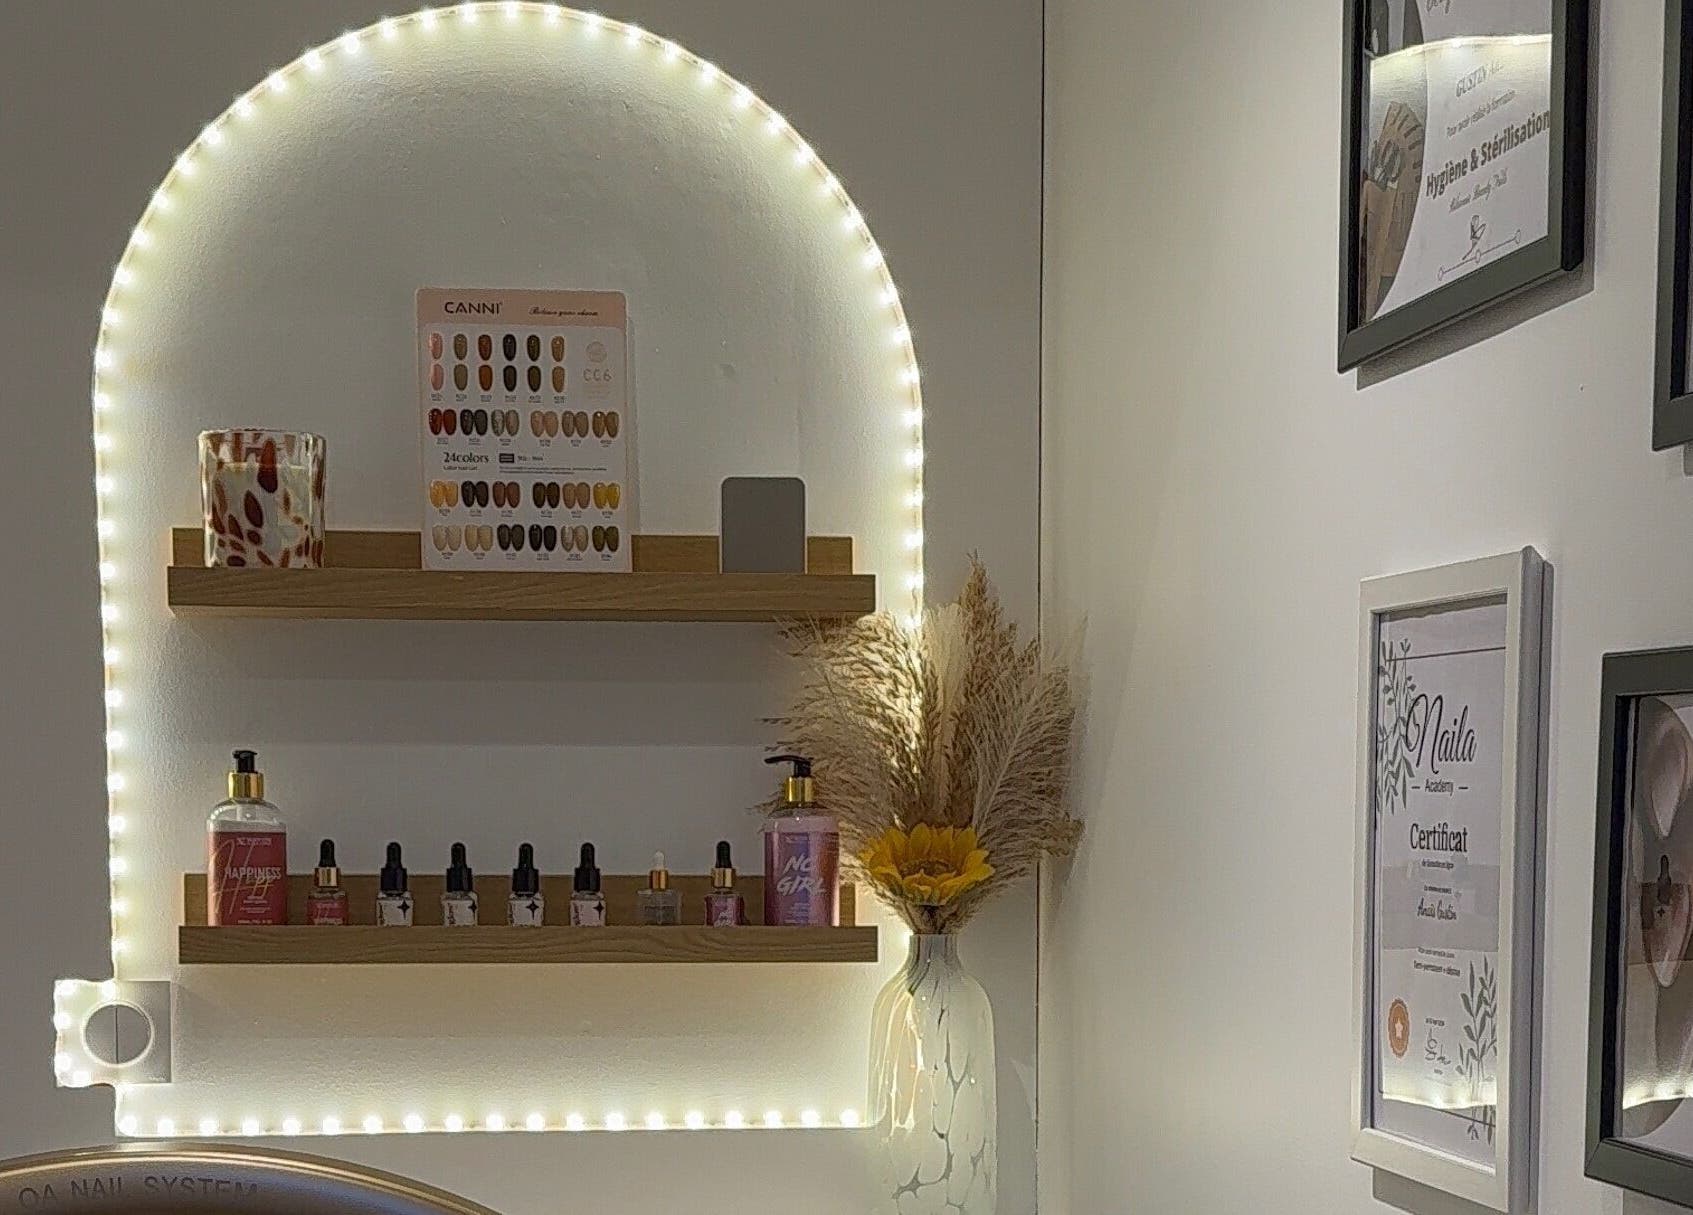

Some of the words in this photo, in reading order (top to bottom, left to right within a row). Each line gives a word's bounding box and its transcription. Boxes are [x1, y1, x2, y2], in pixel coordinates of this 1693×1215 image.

[1426, 159, 1468, 200] Hygiène
[1470, 147, 1479, 172] &
[1480, 110, 1550, 167] Stérilisation
[444, 301, 500, 315] CANNI
[443, 452, 489, 464] 24colors
[1406, 693, 1477, 775] Naila
[1424, 779, 1454, 796] Academy
[1410, 822, 1468, 853] Certificat
[225, 866, 281, 881] HAPPINESS
